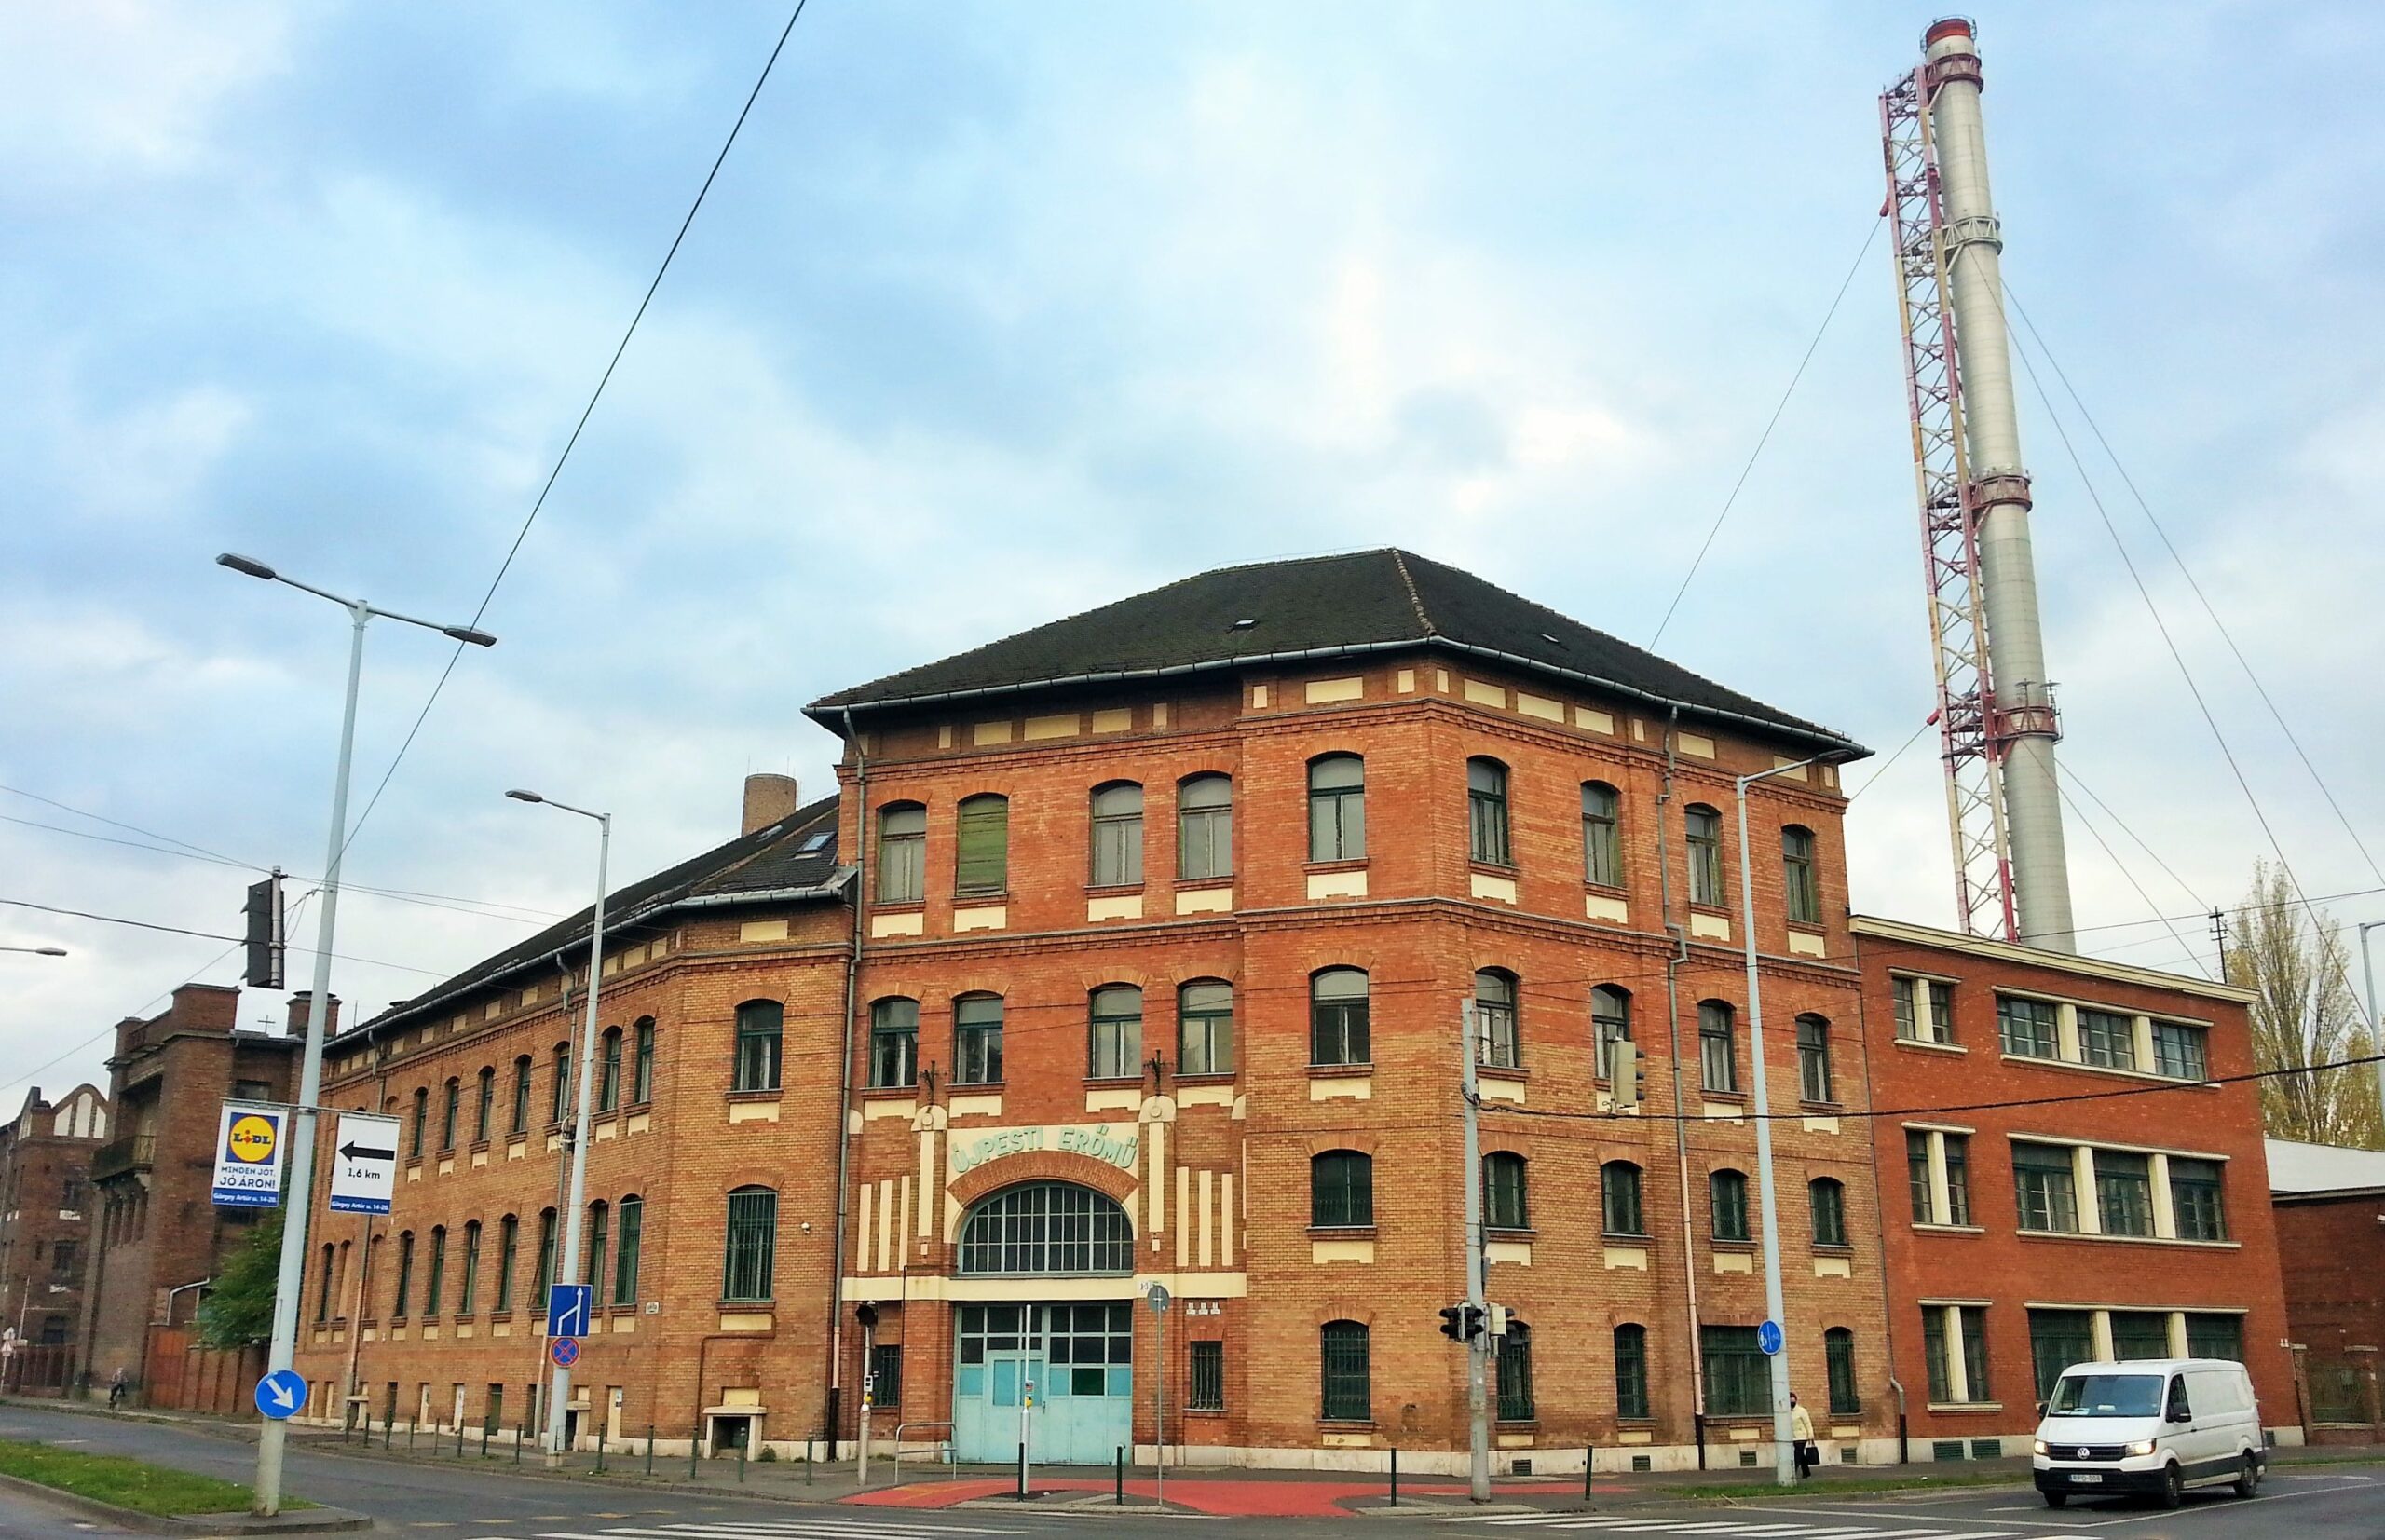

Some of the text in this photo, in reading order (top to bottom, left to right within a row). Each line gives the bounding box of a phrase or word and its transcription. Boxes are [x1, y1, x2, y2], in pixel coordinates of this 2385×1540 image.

[951, 1124, 1138, 1174] ÚJPESTI ERŐMŰ
[220, 1165, 256, 1175] MINDEN
[348, 1167, 381, 1179] 1,6 km
[219, 1174, 276, 1189] JÓ ÁRON!
